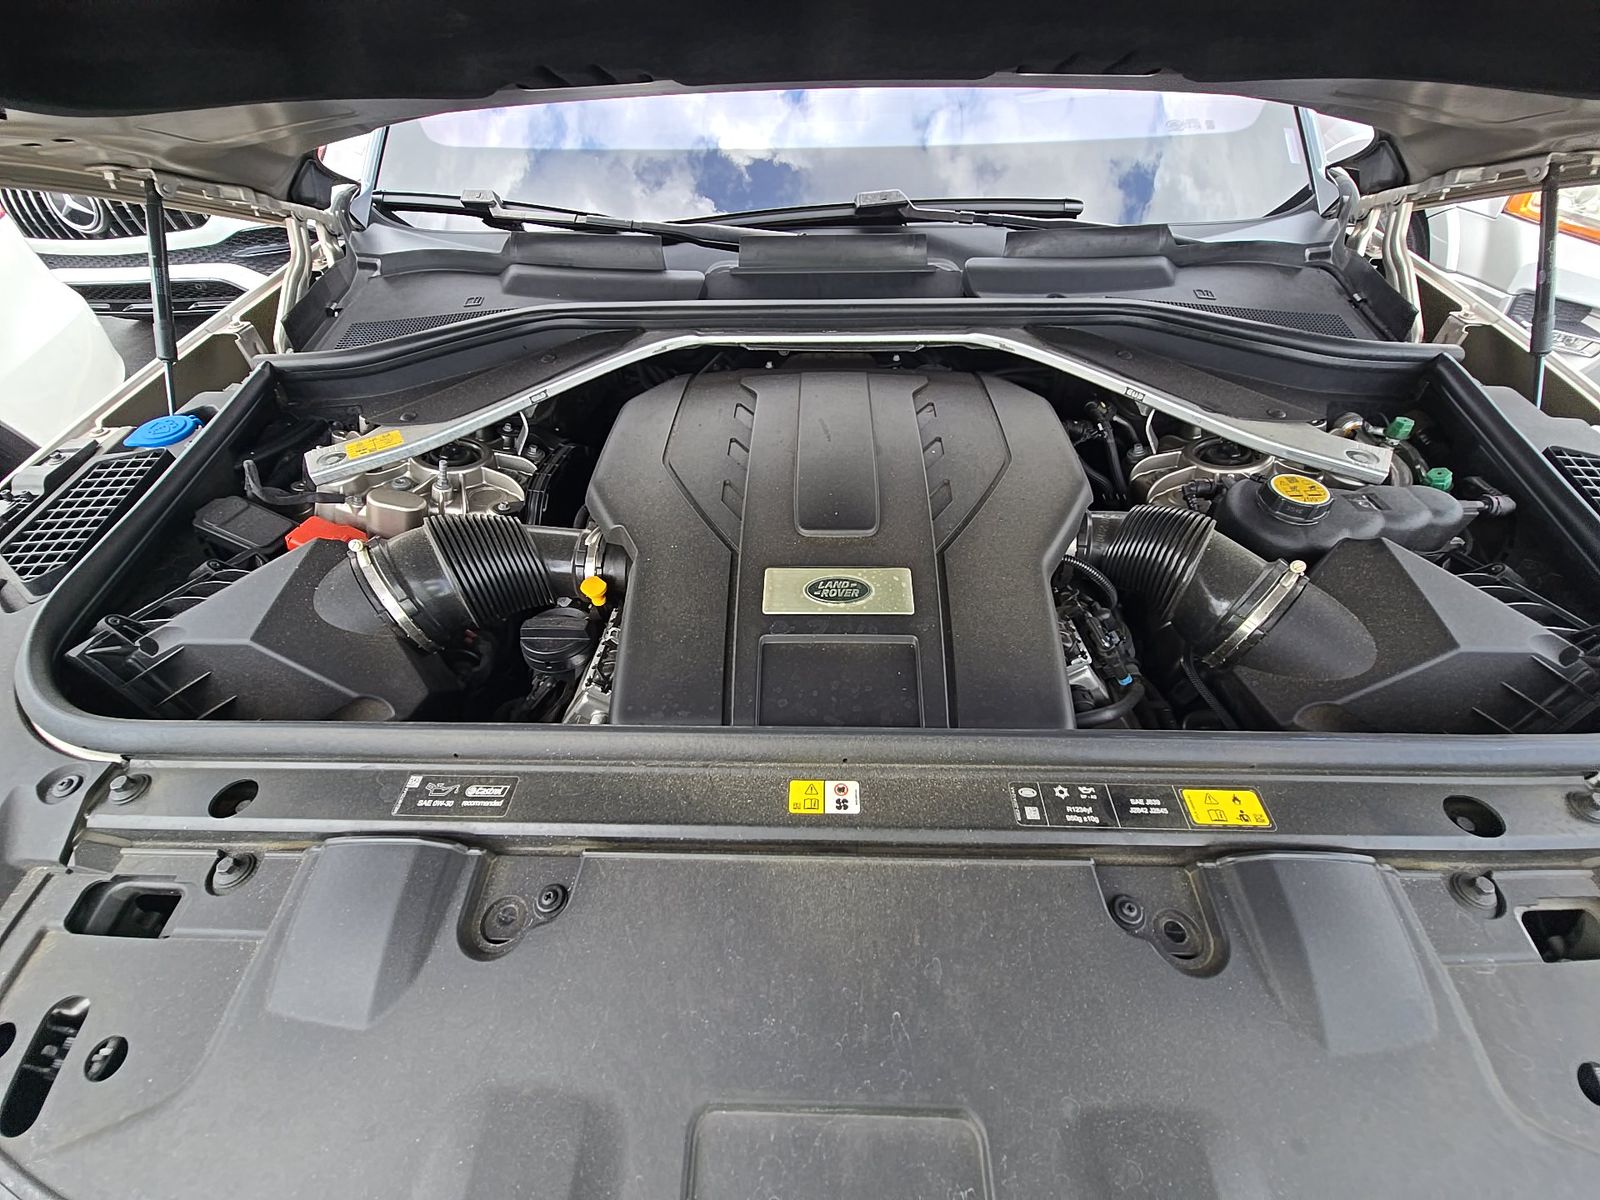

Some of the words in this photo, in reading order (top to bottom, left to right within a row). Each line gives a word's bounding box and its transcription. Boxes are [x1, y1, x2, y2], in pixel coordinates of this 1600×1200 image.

[416, 799, 433, 807] SAE
[461, 799, 505, 807] recommended
[1066, 805, 1093, 814] R1234yf
